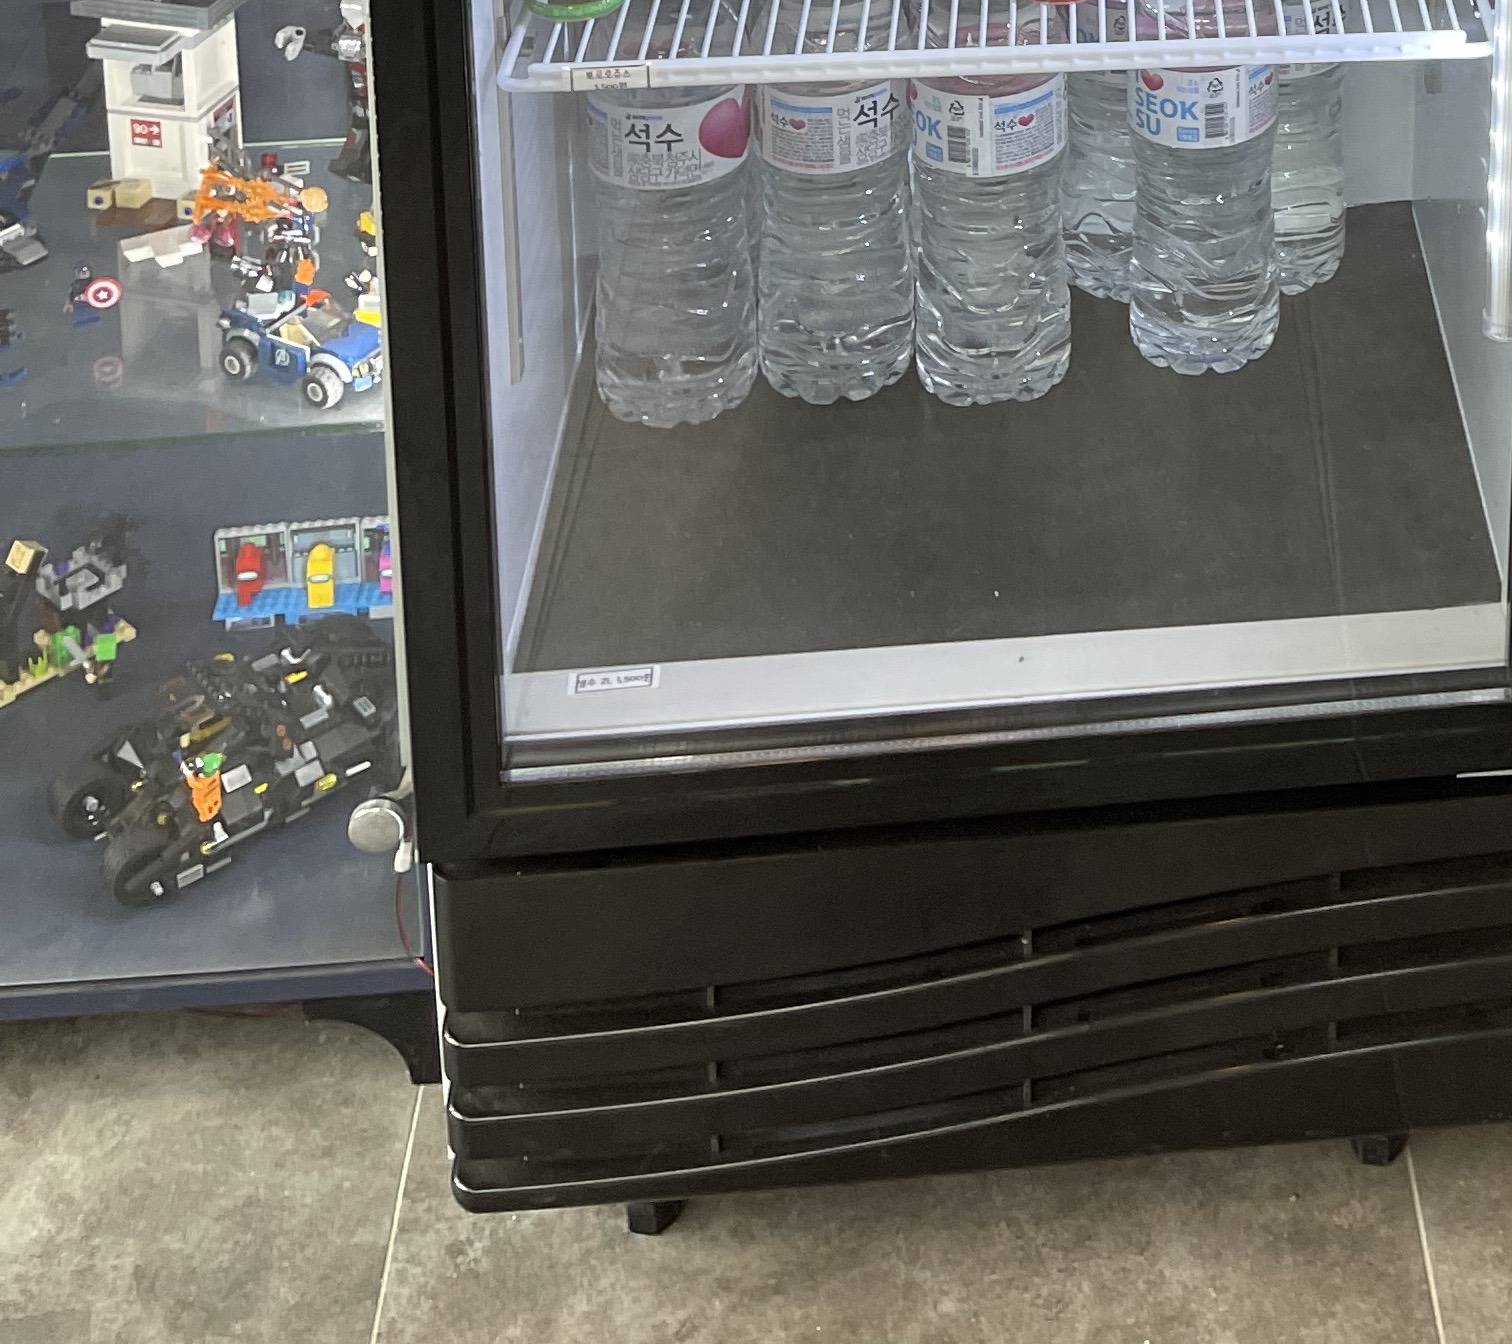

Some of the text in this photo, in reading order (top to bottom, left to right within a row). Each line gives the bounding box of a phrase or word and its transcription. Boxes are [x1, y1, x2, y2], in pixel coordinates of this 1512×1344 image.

[853, 92, 901, 128] 석수
[1135, 86, 1199, 121] SEOK
[624, 122, 685, 153] 석수
[993, 118, 1018, 133] 석수
[1135, 109, 1162, 136] SU
